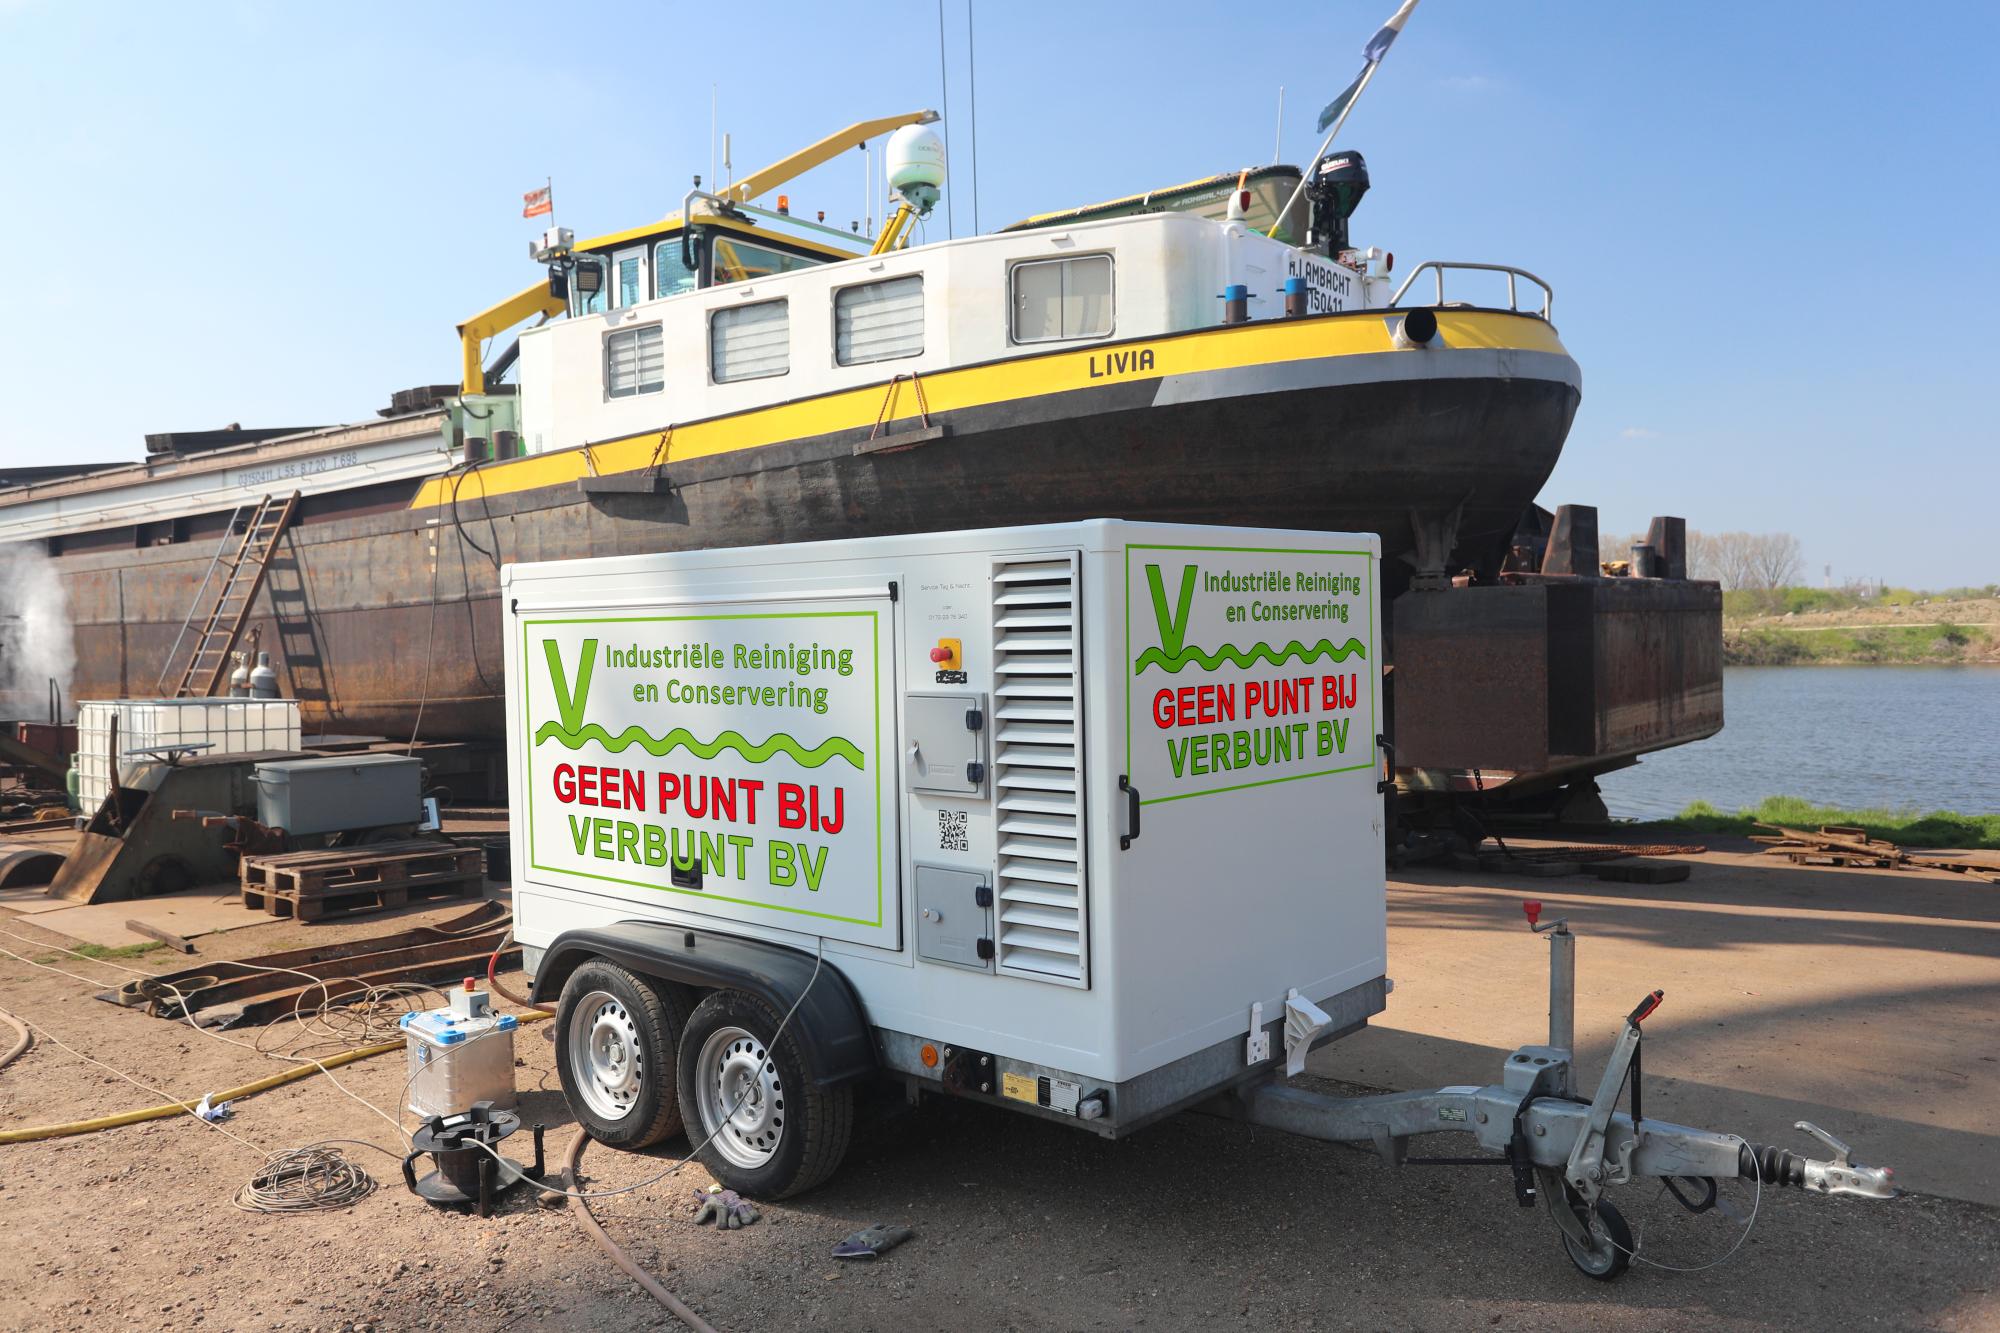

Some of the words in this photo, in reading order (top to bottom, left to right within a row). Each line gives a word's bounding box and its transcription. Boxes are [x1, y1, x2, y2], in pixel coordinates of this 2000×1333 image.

[1306, 288, 1343, 312] 150411
[1090, 349, 1154, 378] LIVIA
[1204, 570, 1291, 592] Industriële
[1297, 572, 1361, 596] Reiniging
[1226, 605, 1246, 622] en
[1251, 600, 1349, 623] Conservering
[606, 643, 724, 669] Industriële
[734, 643, 854, 676] Reiniging
[633, 682, 659, 703] en
[666, 679, 828, 714] Conservering
[1153, 683, 1235, 729] GEEN
[1245, 676, 1314, 719] PUNT
[1322, 674, 1357, 711] BIJ
[1167, 722, 1309, 778] VERBUNT
[1316, 718, 1350, 757] BV
[553, 763, 645, 812] GEEN
[658, 772, 764, 824] PUNT
[778, 782, 844, 834] BIJ
[568, 814, 754, 880] VERBUNT
[769, 840, 829, 892] BV
